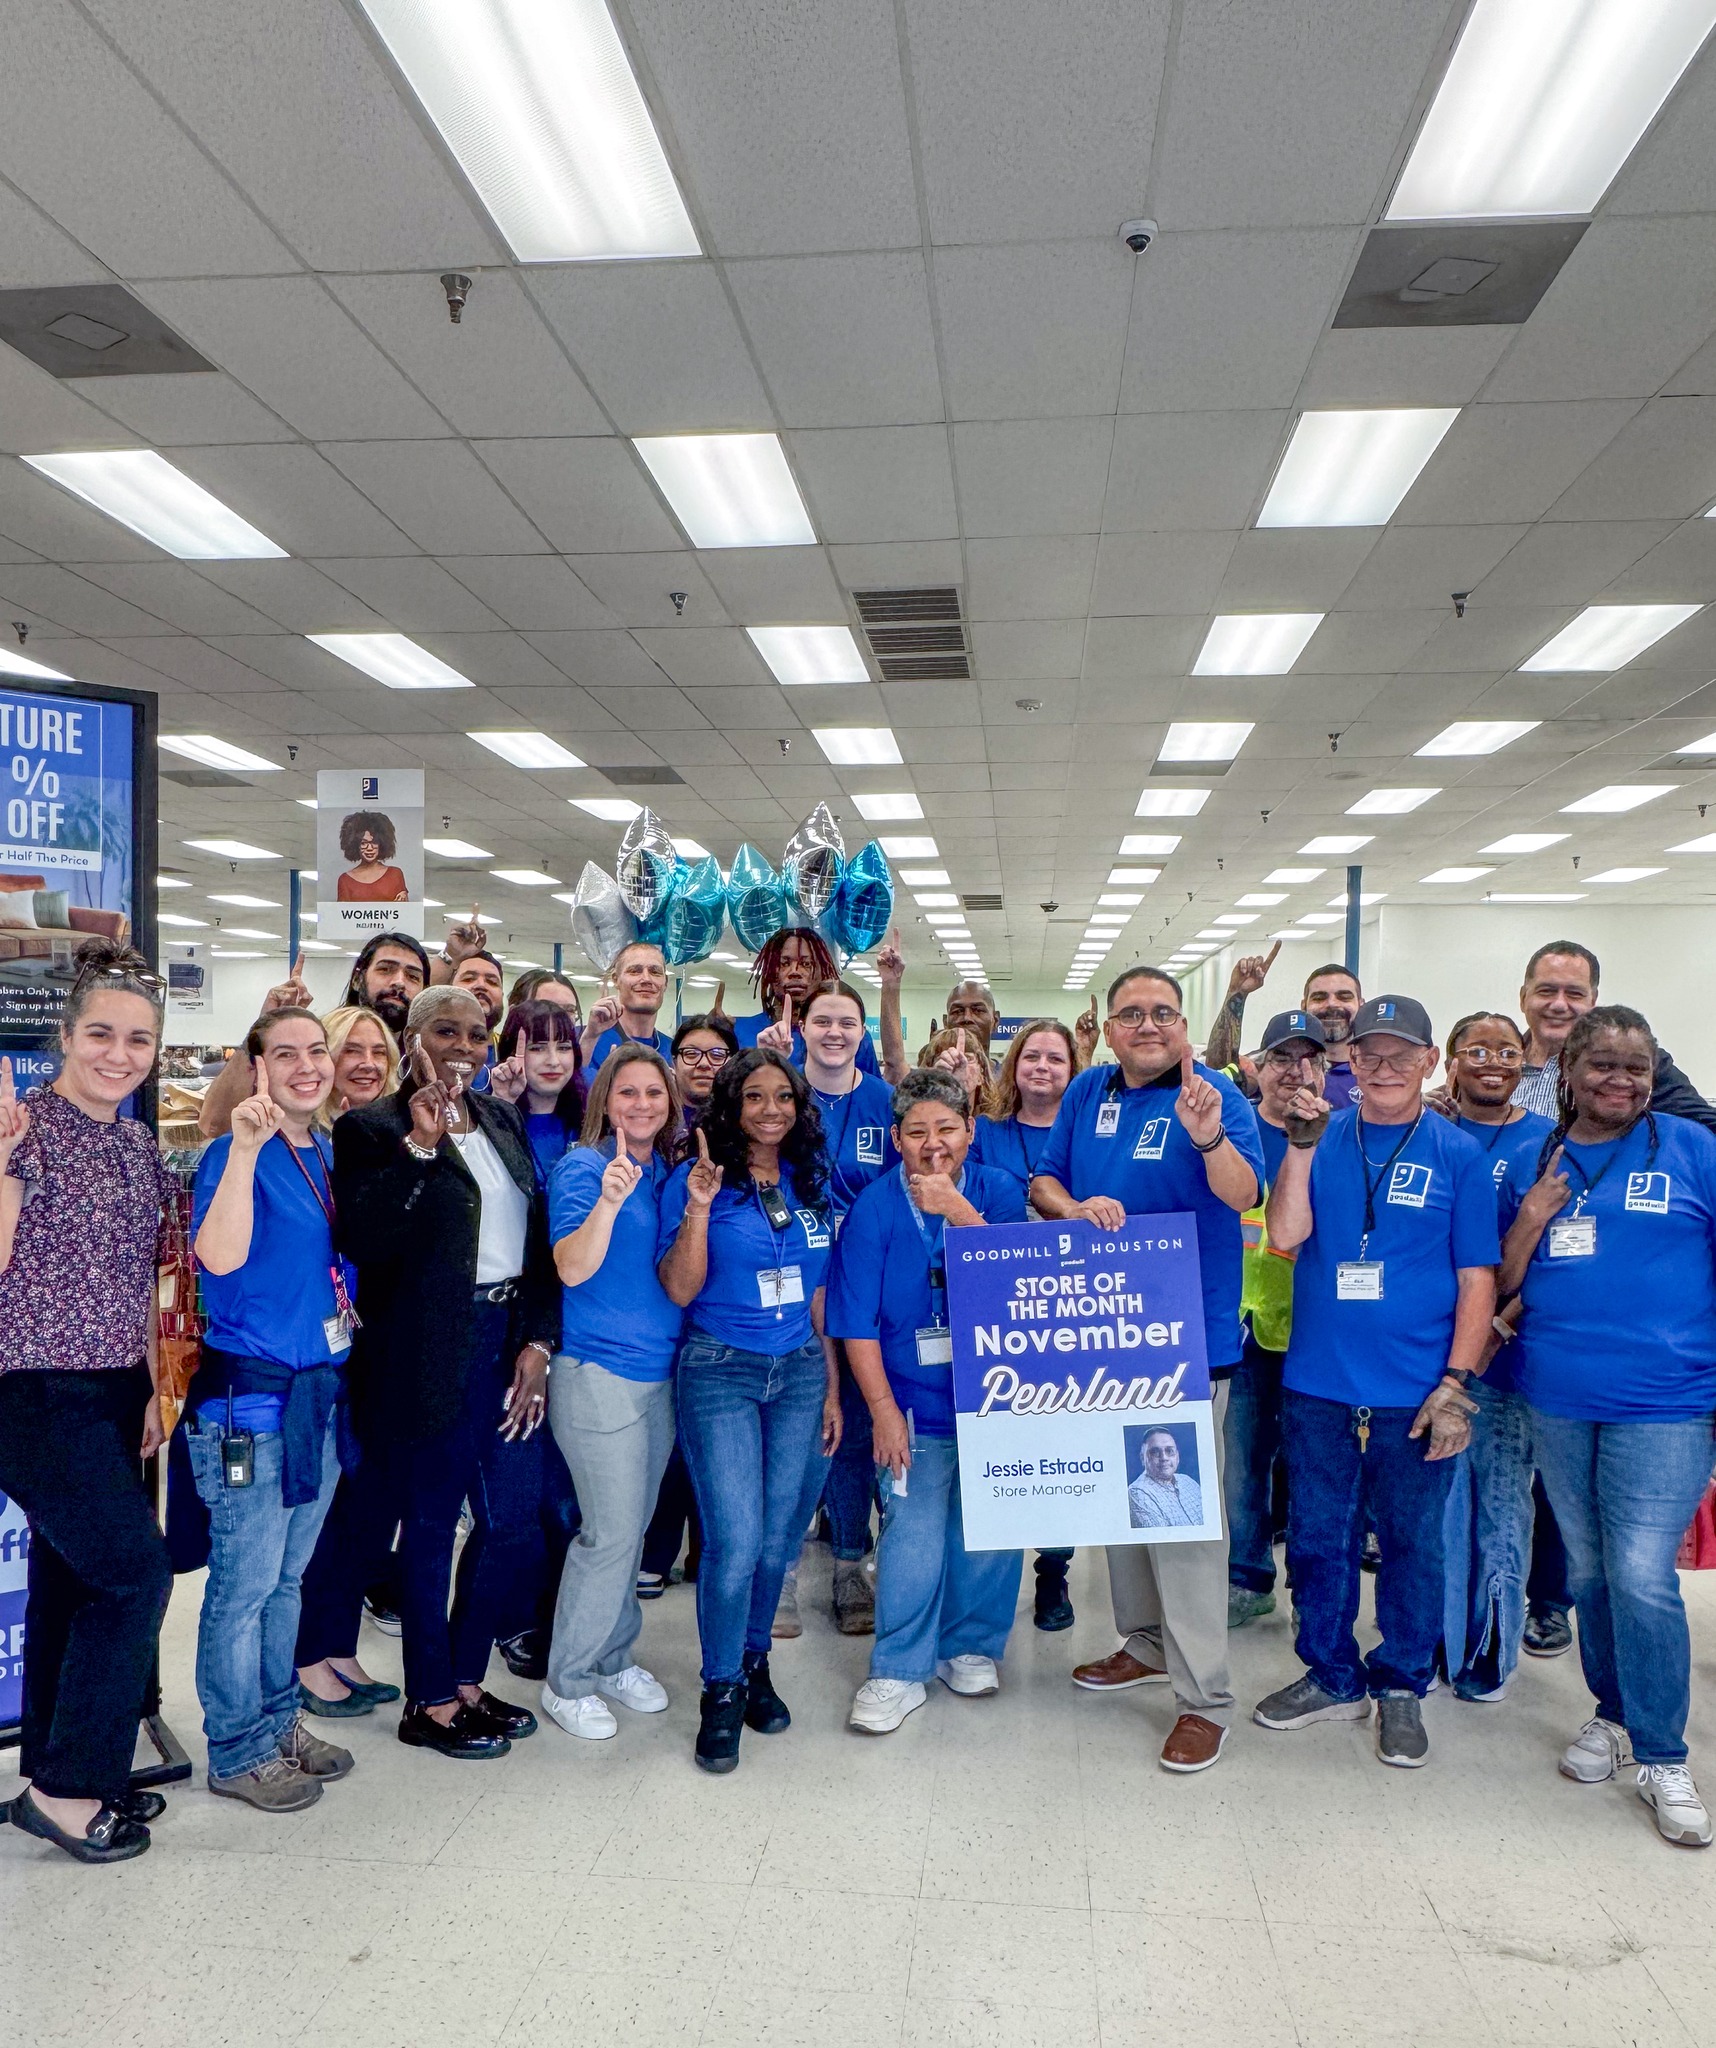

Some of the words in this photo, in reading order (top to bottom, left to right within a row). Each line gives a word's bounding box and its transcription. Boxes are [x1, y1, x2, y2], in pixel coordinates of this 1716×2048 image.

[12, 755, 60, 799] %
[8, 798, 65, 842] OFF
[8, 849, 32, 861] Half
[35, 851, 57, 863] The
[61, 854, 88, 866] Price
[341, 909, 399, 920] WOMEN'S
[0, 986, 24, 995] bers
[27, 986, 52, 998] Only.
[6, 1000, 26, 1011] Sign
[29, 1003, 41, 1011] up
[16, 1057, 54, 1075] like
[962, 1246, 1052, 1262] GOODWILL
[1091, 1238, 1183, 1255] HOUSTON
[1015, 1275, 1087, 1298] STORE
[1094, 1271, 1126, 1293] OF
[1007, 1299, 1049, 1321] THE
[1055, 1293, 1144, 1319] MONTH
[974, 1317, 1184, 1357] November
[976, 1361, 1190, 1417] Pearland
[982, 1460, 1035, 1479] Jessie
[1039, 1456, 1104, 1476] Estrada
[992, 1485, 1031, 1498] Store
[1032, 1483, 1097, 1498] Manager
